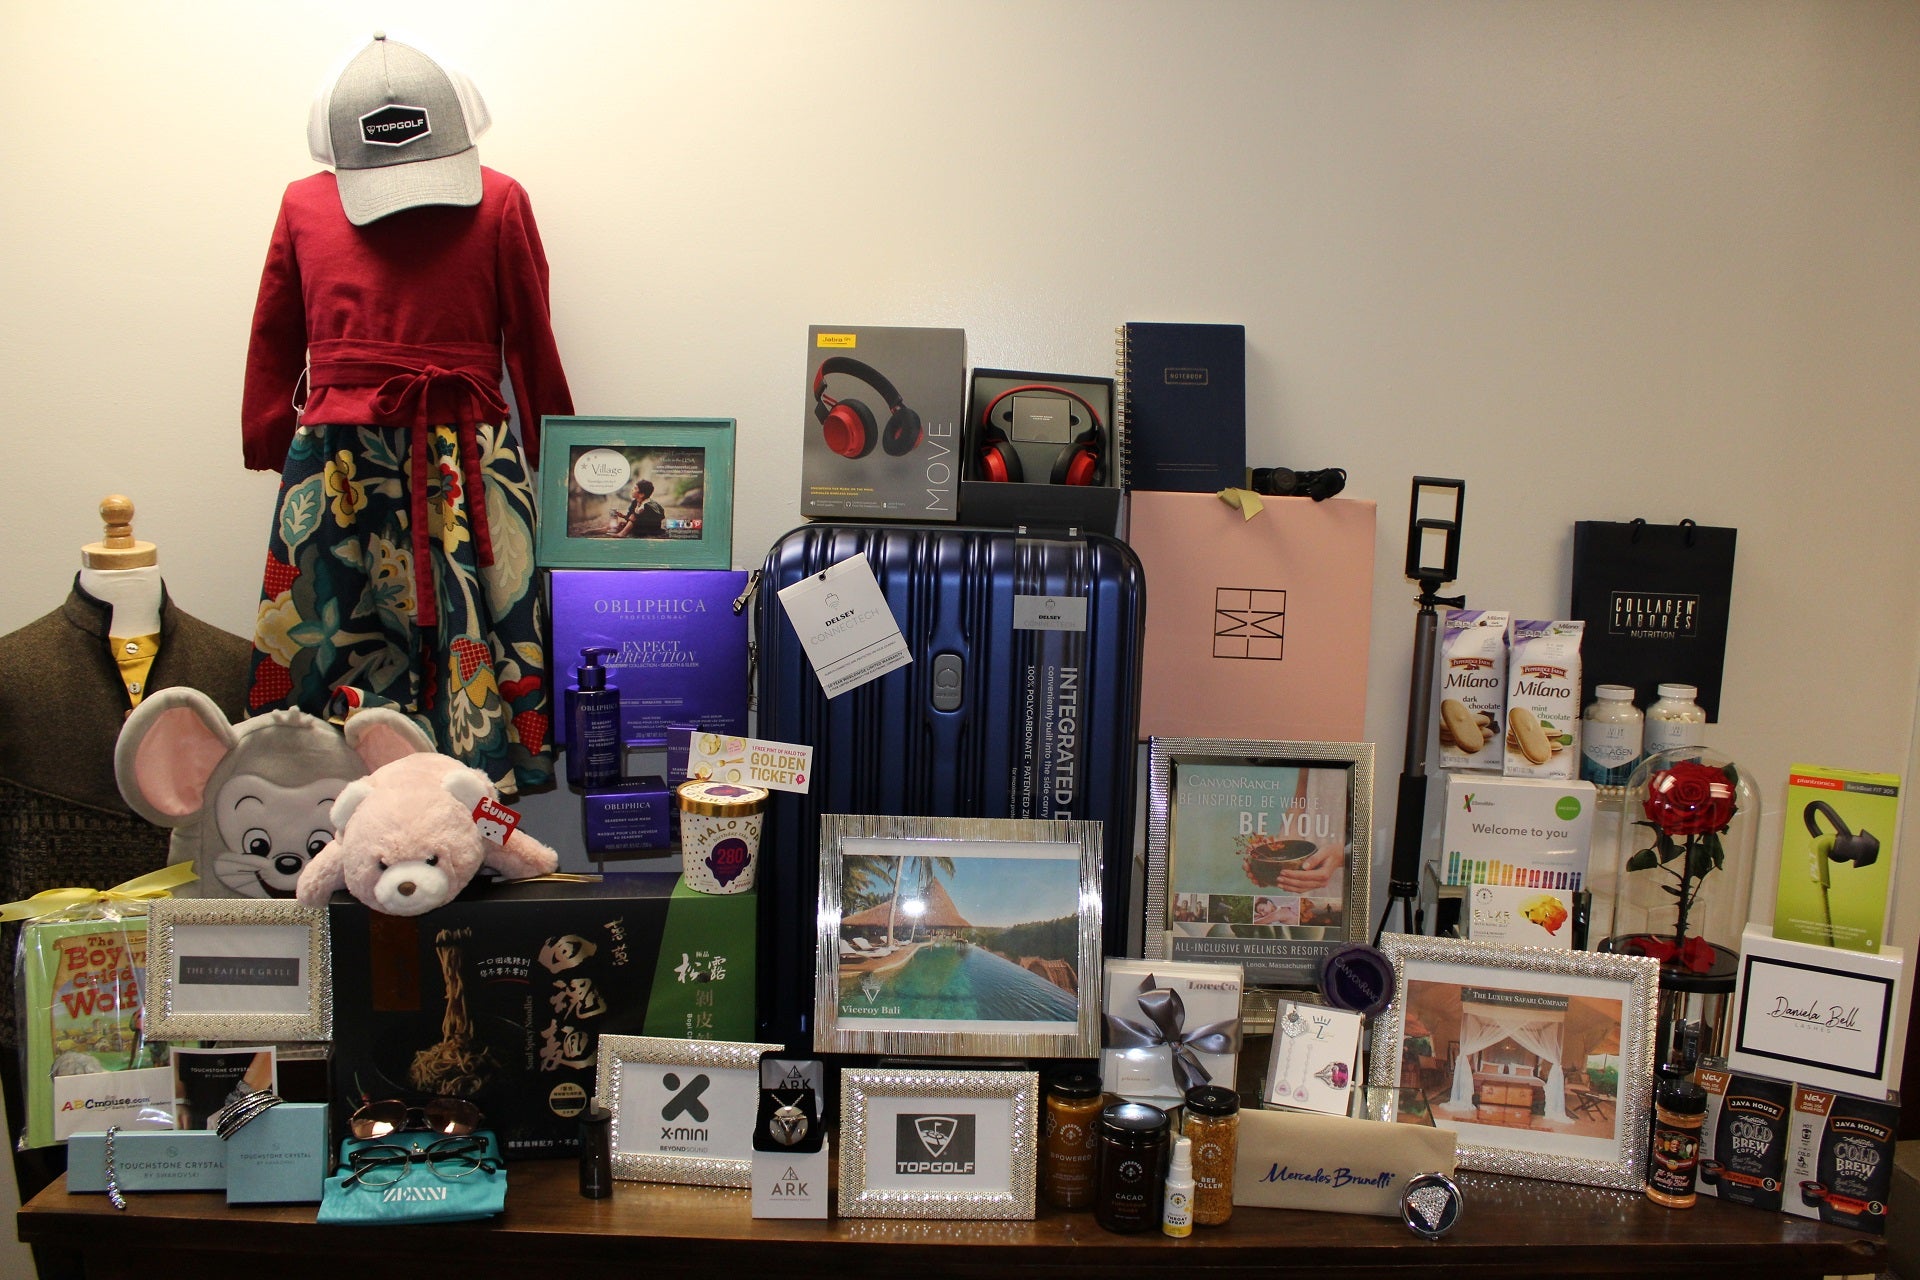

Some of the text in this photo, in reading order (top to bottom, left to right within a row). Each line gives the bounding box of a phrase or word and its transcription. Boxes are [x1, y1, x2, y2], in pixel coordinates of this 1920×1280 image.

[375, 118, 424, 133] TOPGOLF
[591, 463, 623, 475] Village
[925, 422, 952, 511] MOVE
[594, 599, 707, 614] OBLIPHICA
[1615, 597, 1693, 615] COLLAGEN
[825, 608, 857, 627] DELSEY
[809, 606, 881, 646] CONNECTECH
[1630, 629, 1676, 639] NUTRITION
[622, 640, 681, 653] EXPECT
[605, 651, 697, 664] PERFECTION
[1444, 672, 1499, 689] Milano
[1513, 681, 1571, 699] Milano
[1462, 695, 1478, 703] dark
[1468, 702, 1501, 710] chocolate
[1531, 704, 1548, 712] mint
[1537, 713, 1571, 721] chocolate
[1022, 664, 1035, 808] 100% POLYCARBONATE PATENTED
[1040, 665, 1055, 818] conveniently built into the side carry
[1055, 667, 1078, 804] INTEGRATED
[750, 751, 806, 771] GOLDEN
[750, 766, 796, 785] TICKET
[1189, 774, 1281, 790] CANYONRANCH
[1796, 777, 1836, 788] plantronics
[604, 801, 651, 811] OBLIPHICA
[1179, 793, 1194, 805] BE
[1261, 796, 1275, 808] BE
[481, 802, 515, 824] GUND
[1239, 811, 1335, 838] BE YOU.
[1472, 823, 1569, 840] Welcome to you
[697, 820, 760, 846] HALO TOP
[717, 847, 744, 865] 280
[87, 936, 115, 947] The
[1175, 942, 1329, 956] ALL-INCLUSIVE WELLNESS RESORTS
[64, 946, 124, 971] Boy
[186, 966, 204, 975] THE
[673, 953, 727, 984] 松露
[72, 967, 135, 989] Cried
[60, 982, 138, 1019] Wolf
[1472, 991, 1568, 1008] THE LUXURY SAFARI COMPANY
[841, 1005, 901, 1017] Viceroy Bali
[1769, 996, 1860, 1028] Daniela Bell
[1701, 1072, 1722, 1085] NEW
[61, 1097, 150, 1112] ABCmouse.com
[1803, 1093, 1827, 1104] NEW
[1731, 1100, 1778, 1115] JAVA HOUSE
[1729, 1120, 1774, 1143] COLD
[1835, 1121, 1857, 1129] JAVA
[1857, 1122, 1886, 1137] HOUSE
[1732, 1136, 1770, 1155] BREW
[1736, 1148, 1763, 1159] COFFEE
[1833, 1141, 1881, 1166] COLD
[119, 1161, 225, 1170] TOUCHSTONE CRYSTAL
[897, 1161, 975, 1174] TOPGOLF
[1835, 1157, 1876, 1178] BREW
[1259, 1163, 1396, 1189] Mercedes Brunelli
[1840, 1170, 1868, 1182] COFFEE
[382, 1186, 447, 1204] ZENNI
[771, 1182, 809, 1197] ARK
[1115, 1193, 1144, 1201] CACAO
